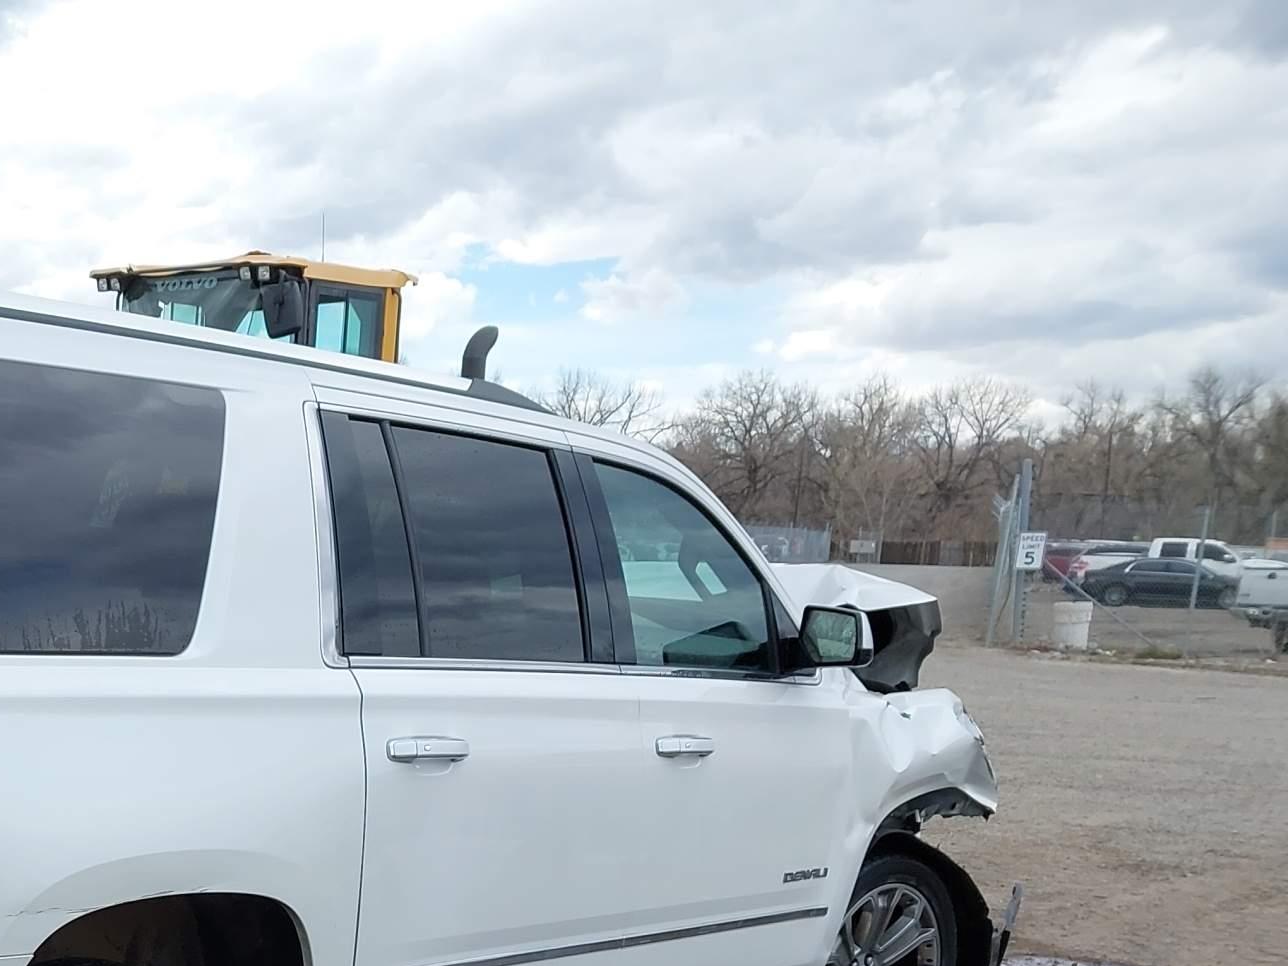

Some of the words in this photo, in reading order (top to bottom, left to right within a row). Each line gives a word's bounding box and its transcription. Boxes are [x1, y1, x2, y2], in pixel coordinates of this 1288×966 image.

[154, 276, 218, 292] VOLVO
[1023, 551, 1035, 565] 5
[782, 867, 829, 884] DENALI
